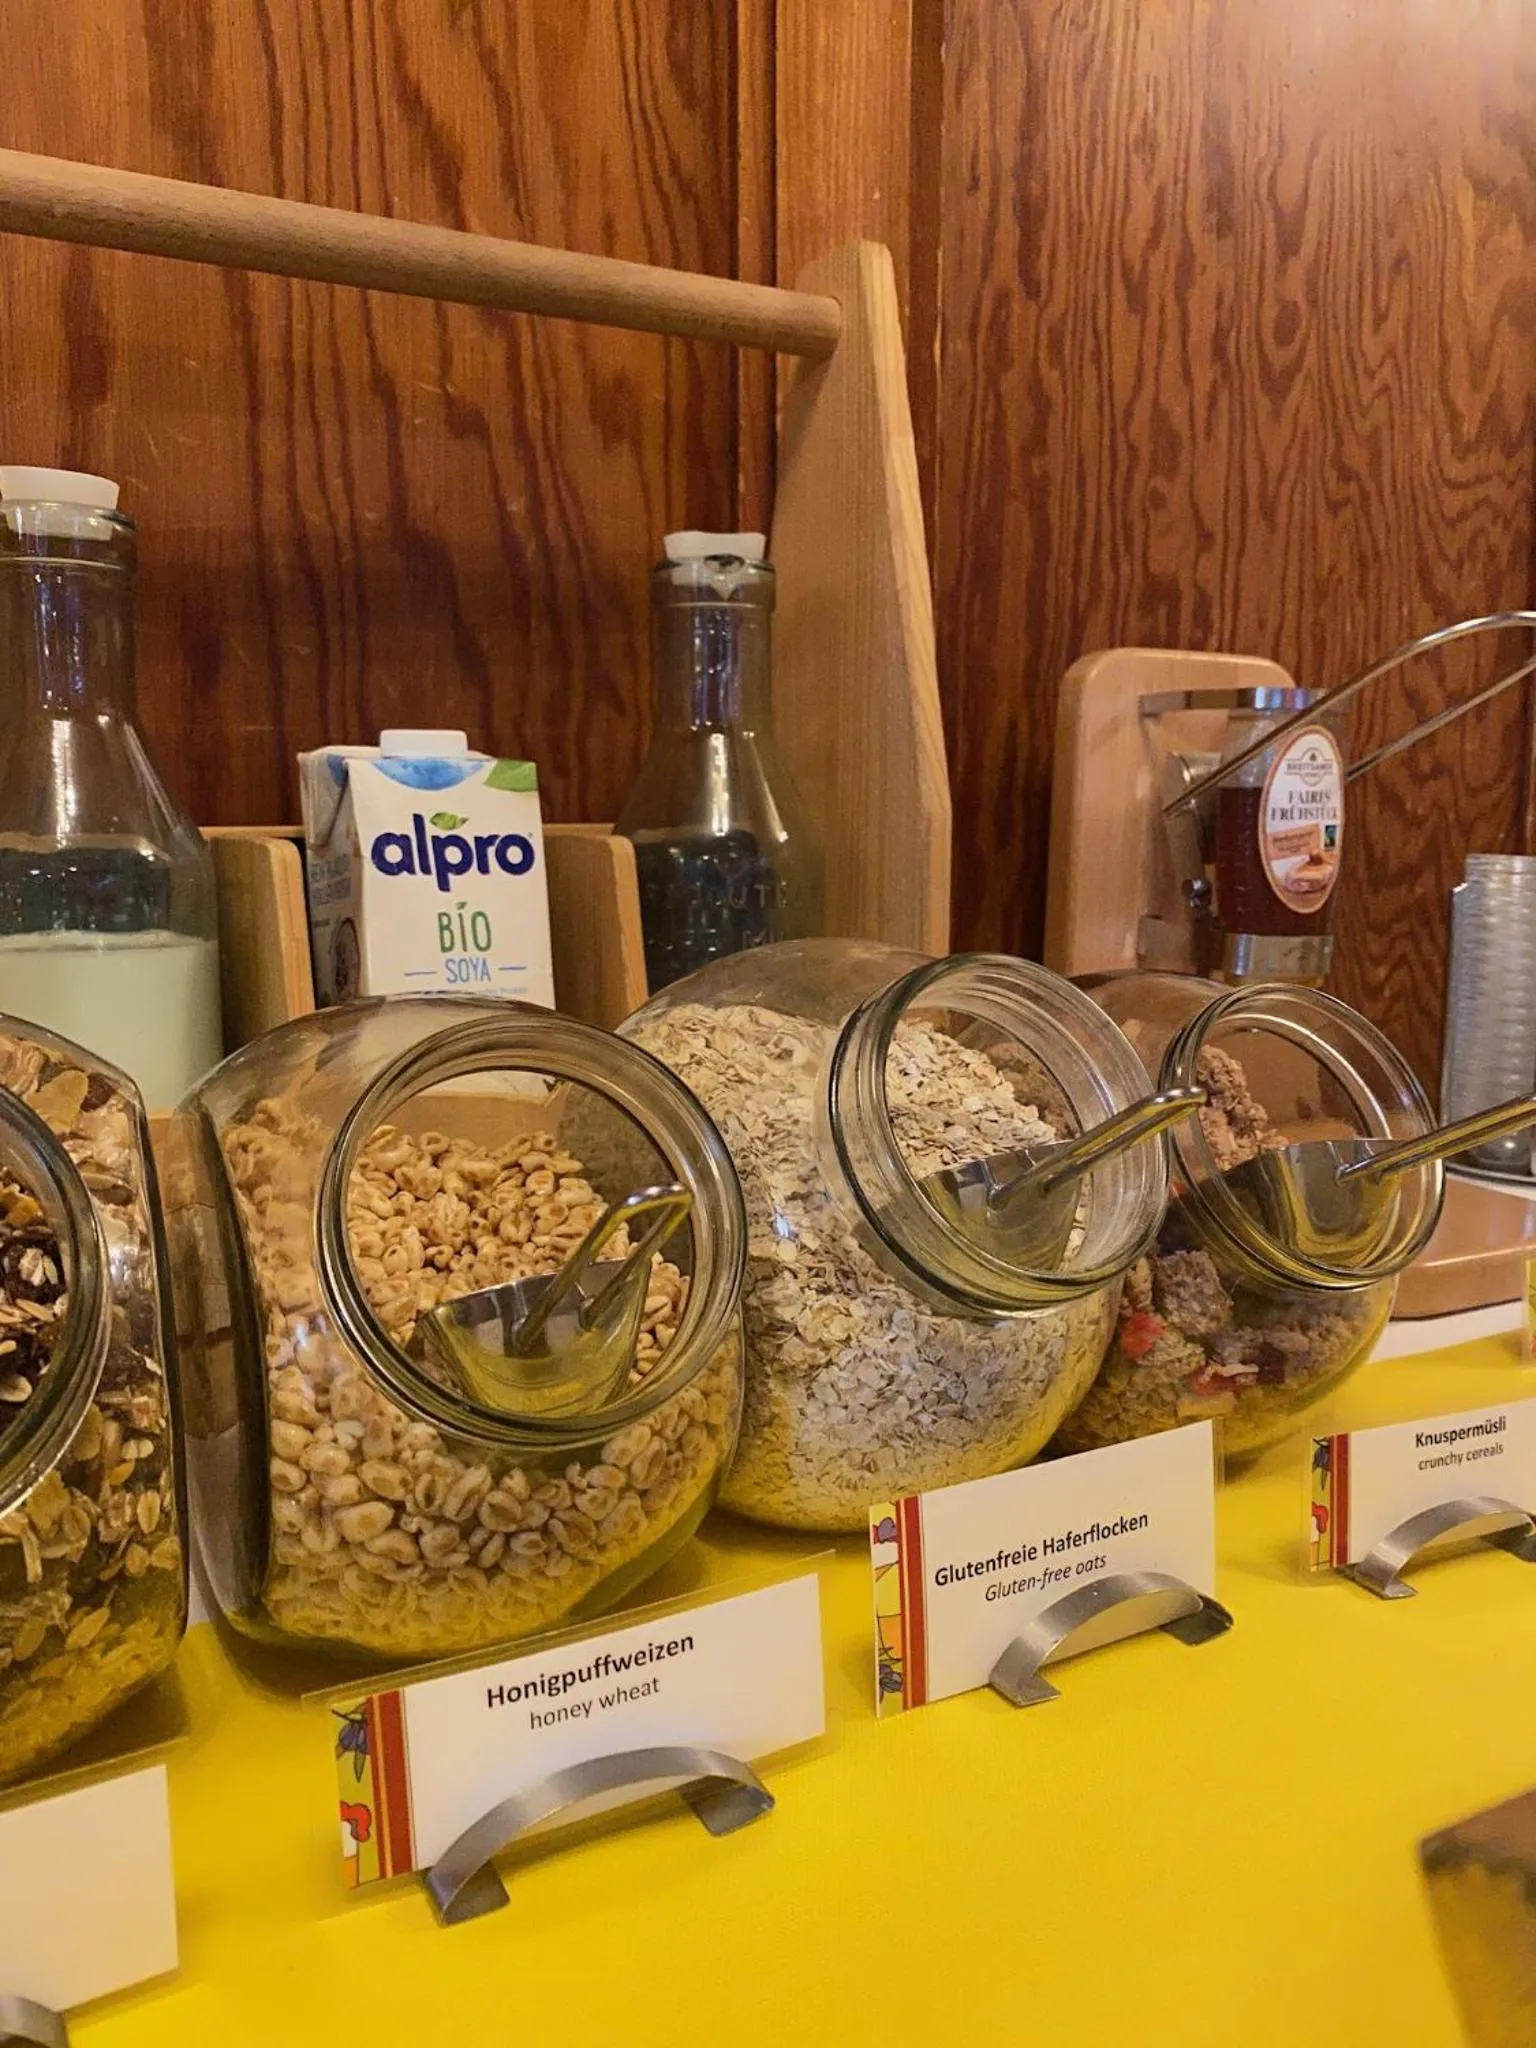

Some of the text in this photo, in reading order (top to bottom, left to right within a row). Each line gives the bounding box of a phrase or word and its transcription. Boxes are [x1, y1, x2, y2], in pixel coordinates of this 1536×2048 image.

[371, 813, 535, 892] alpro
[444, 957, 491, 983] SOYA
[1415, 1415, 1507, 1448] Knuspermüsli
[1418, 1442, 1504, 1471] crunchy cereals
[934, 1513, 1149, 1586] Glutenfreie Haferflocken
[984, 1553, 1107, 1602] Gluten-free oats
[486, 1635, 695, 1709] Honigpuffweizen
[529, 1677, 661, 1730] honey wheat
